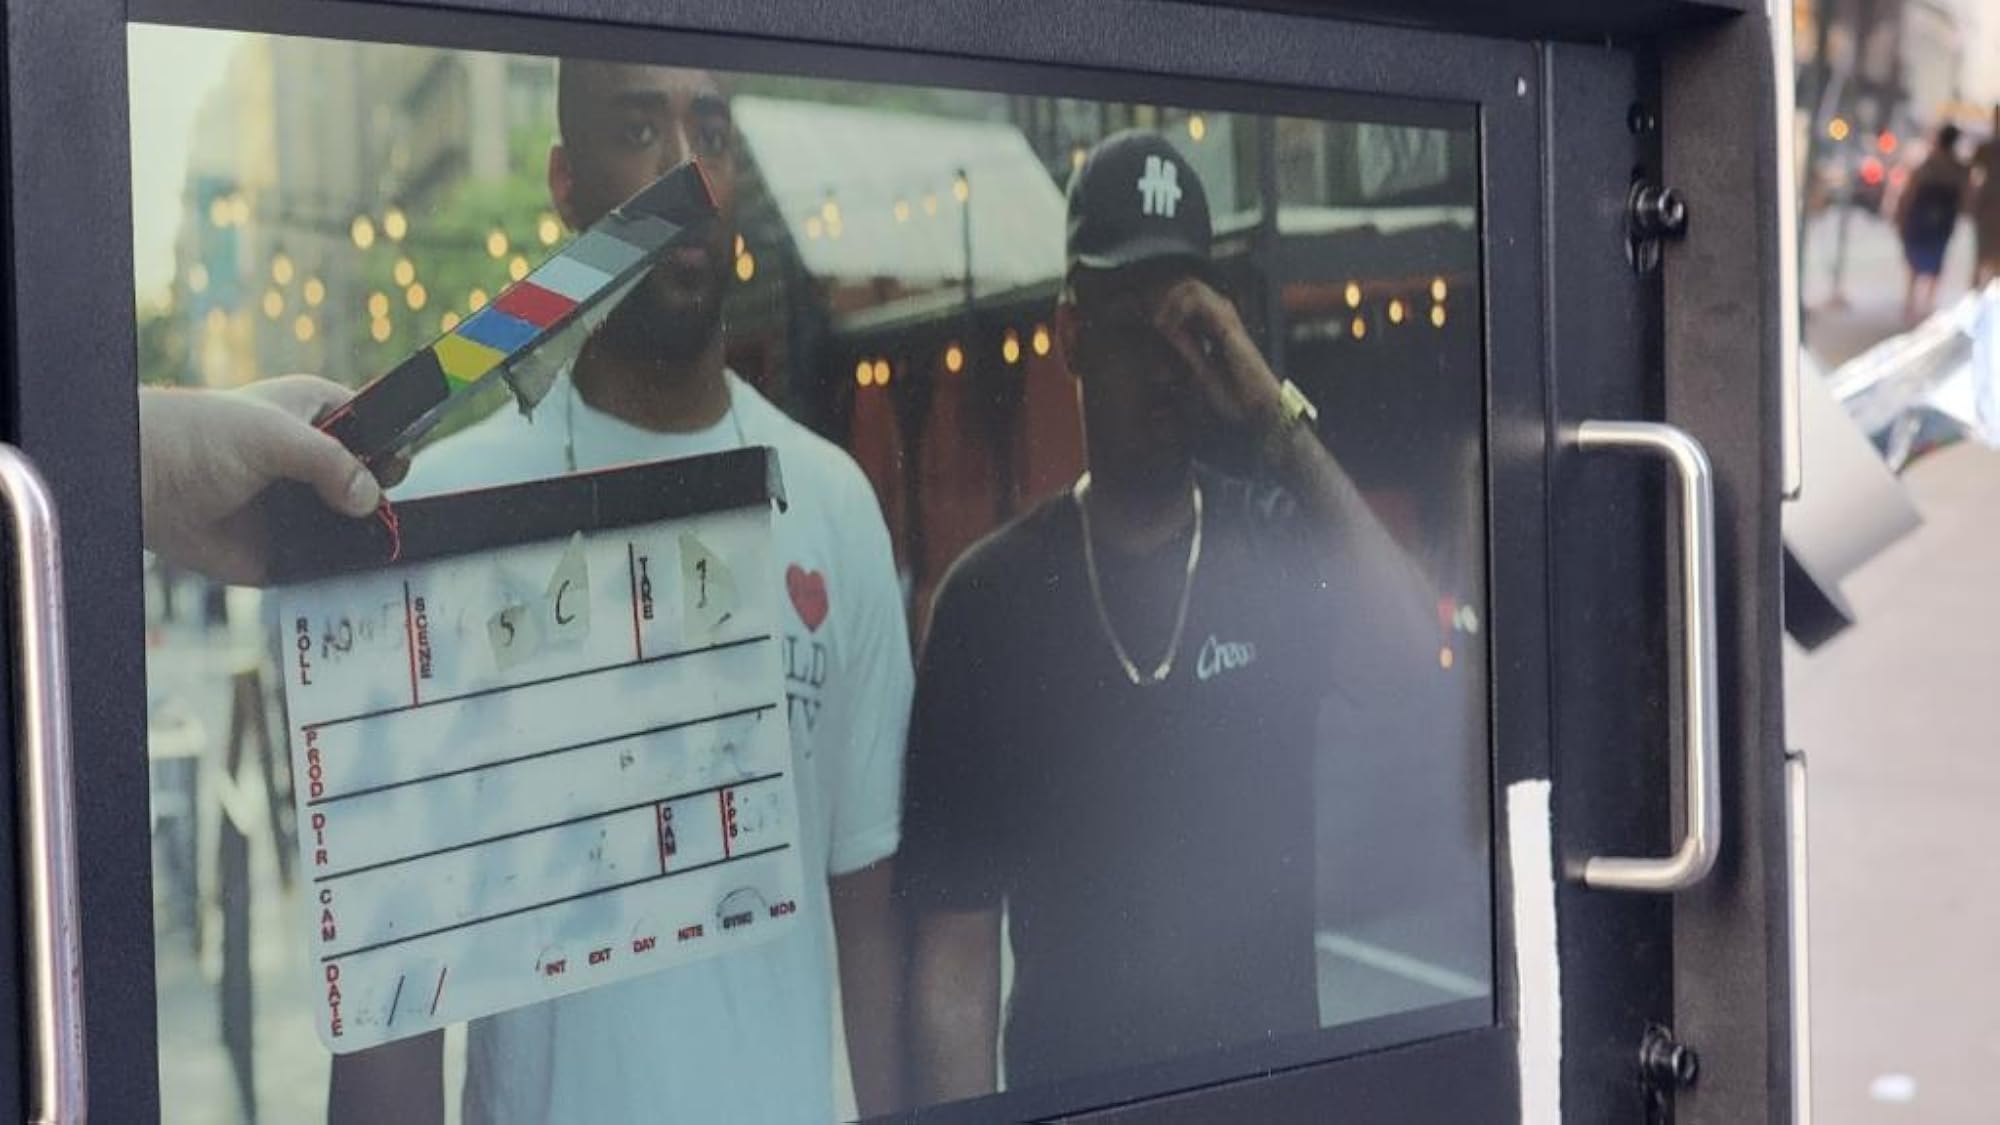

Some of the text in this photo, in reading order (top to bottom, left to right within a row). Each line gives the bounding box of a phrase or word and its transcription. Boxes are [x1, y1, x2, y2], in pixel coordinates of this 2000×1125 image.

[639, 556, 654, 620] TAKE
[295, 616, 313, 686] ROLL
[414, 596, 433, 680] SCENE
[783, 634, 827, 689] LD
[304, 730, 324, 798] PROD
[311, 812, 328, 865] DIR
[318, 888, 336, 942] CAM
[588, 948, 612, 965] EXT
[633, 936, 657, 953] DAY
[325, 964, 343, 1037] DATE
